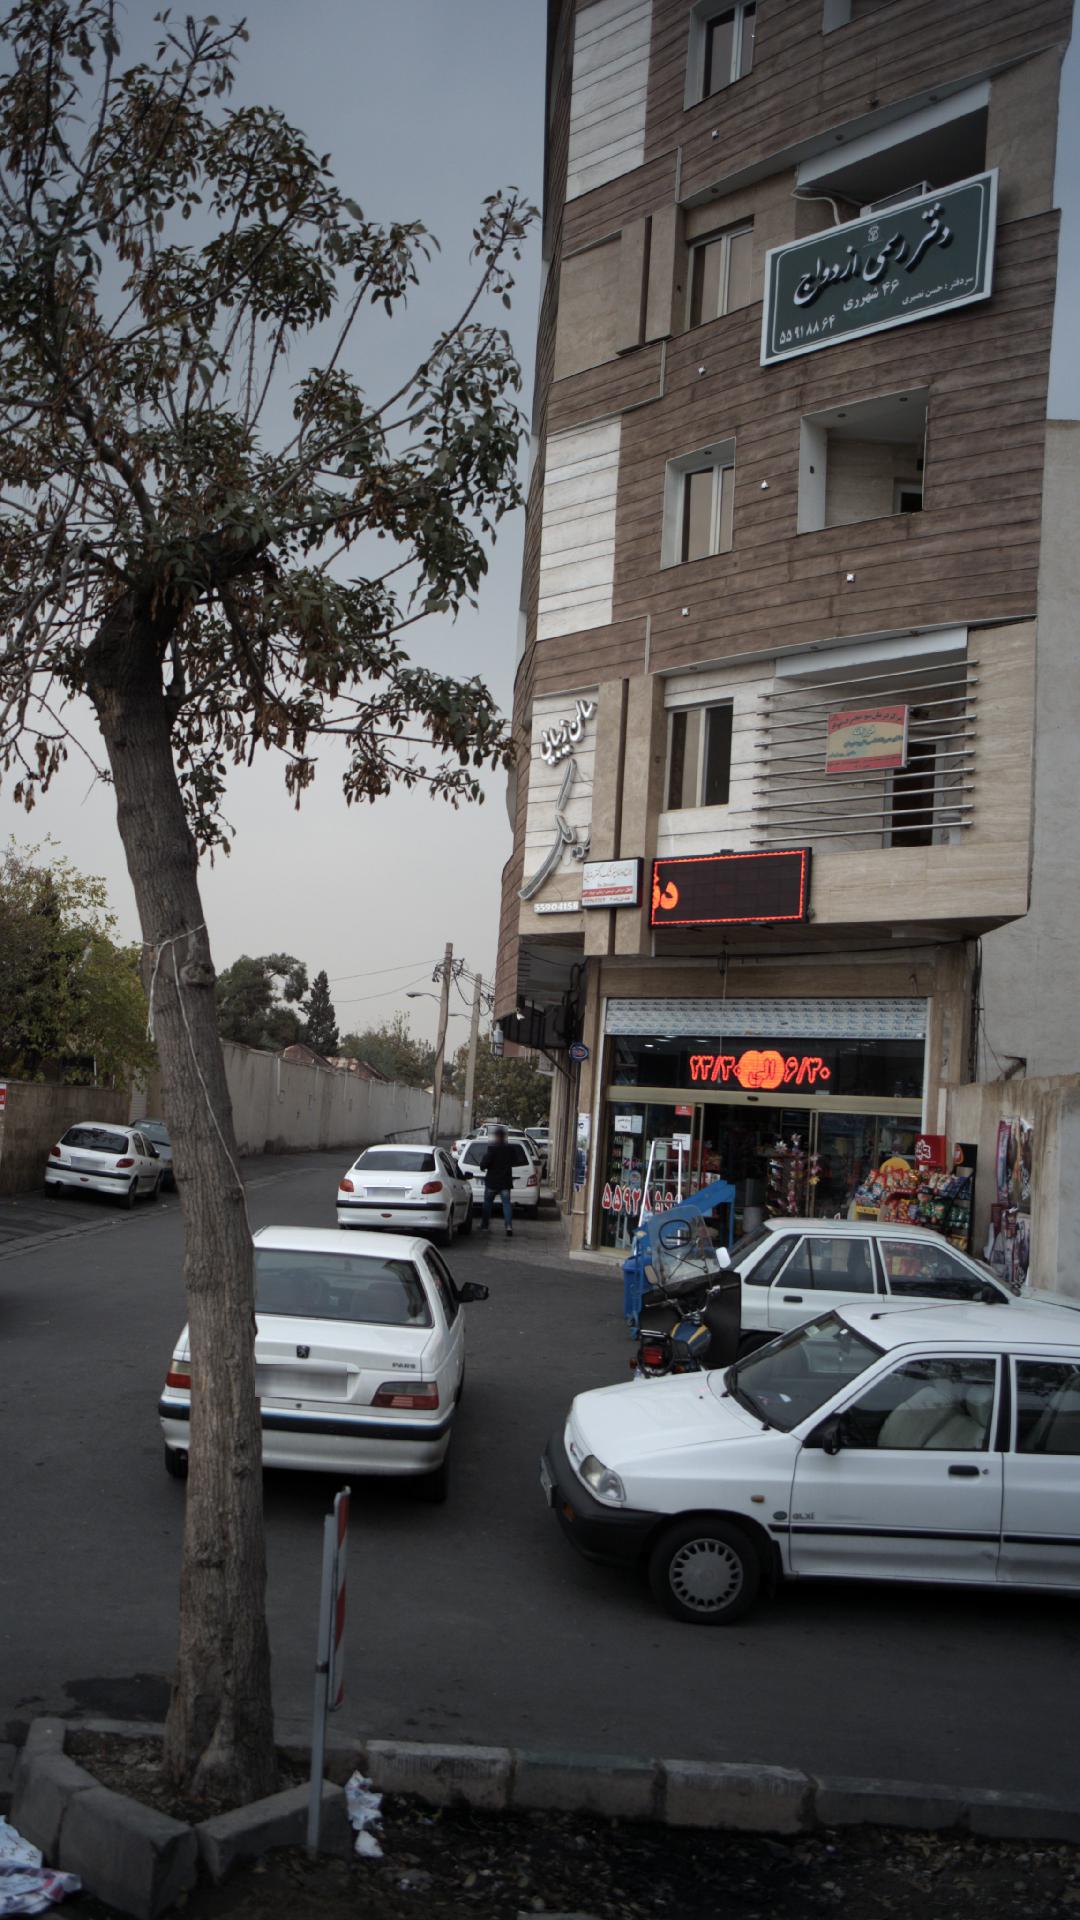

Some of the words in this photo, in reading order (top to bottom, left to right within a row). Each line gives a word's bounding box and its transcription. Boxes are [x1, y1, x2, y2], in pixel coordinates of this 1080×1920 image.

[862, 232, 906, 281] رسمی
[904, 203, 950, 269] دفتر
[793, 246, 858, 305] ازدواج
[881, 279, 899, 297] ۴۶
[843, 287, 879, 311] شهرری
[540, 719, 570, 765] زیبایی
[568, 699, 595, 742] سالن
